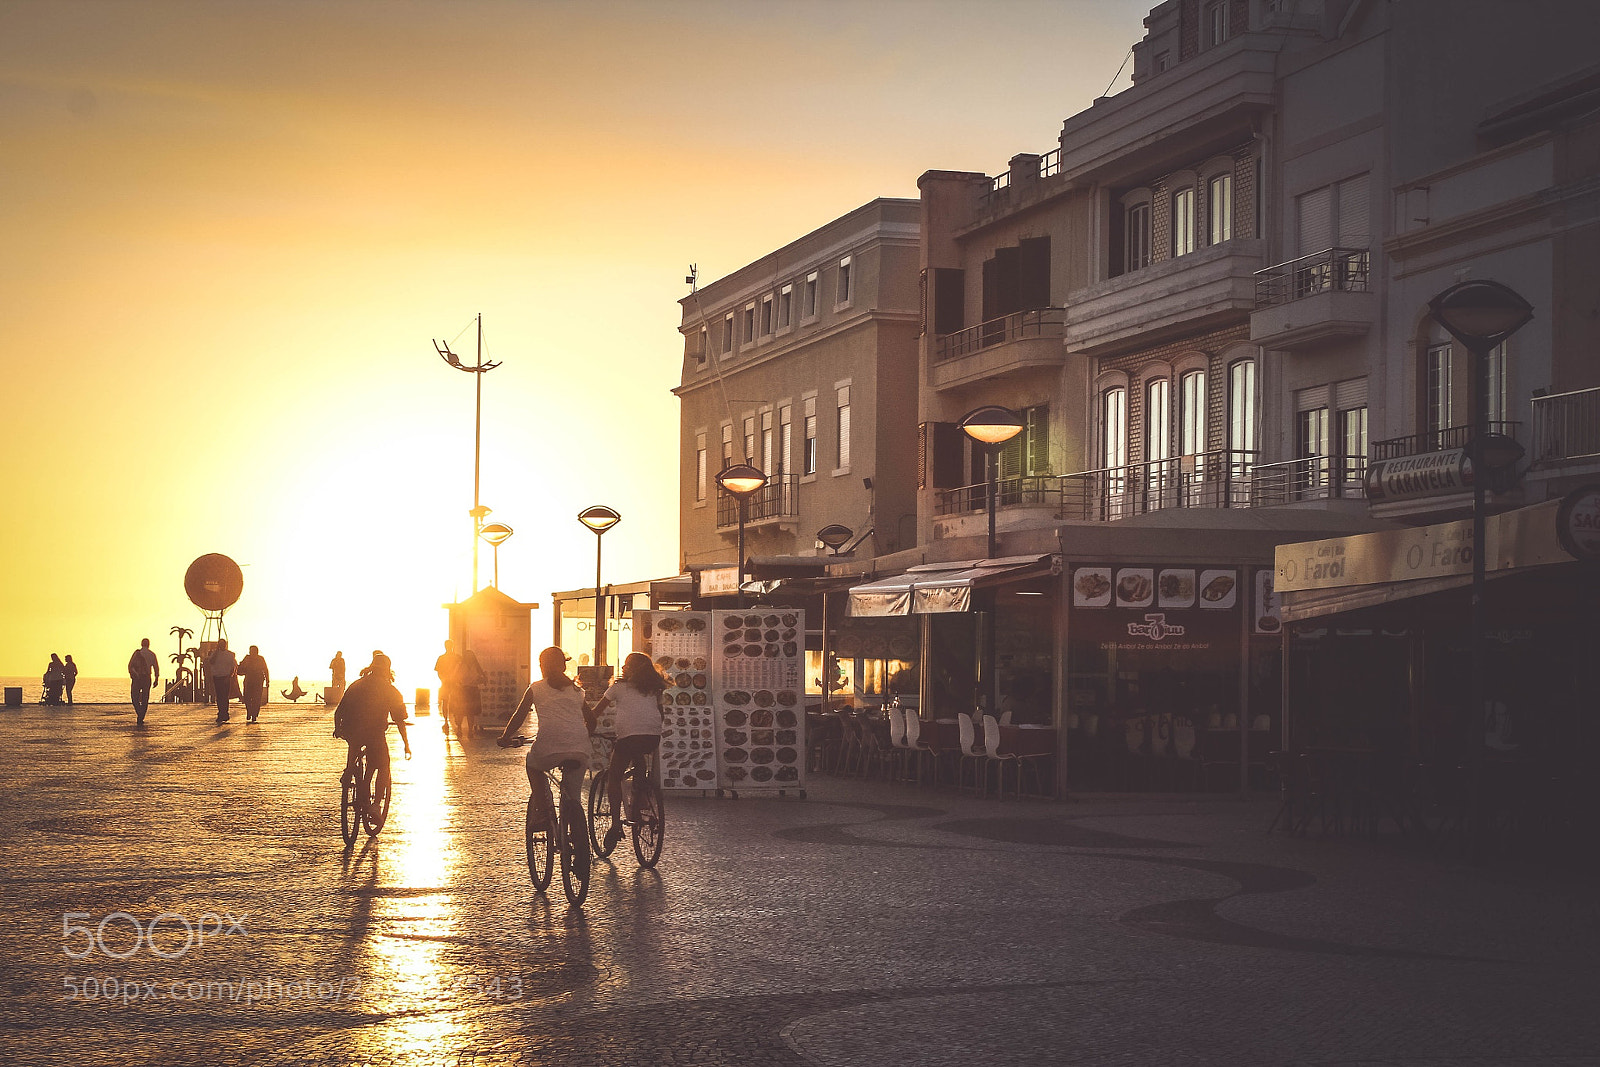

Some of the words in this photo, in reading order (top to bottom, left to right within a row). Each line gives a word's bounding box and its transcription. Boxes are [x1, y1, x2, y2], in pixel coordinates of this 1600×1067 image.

[1386, 452, 1458, 475] RESTAURANTE
[1388, 467, 1457, 496] CARAVELA
[1430, 541, 1473, 568] Faro
[1303, 556, 1346, 581] Farol
